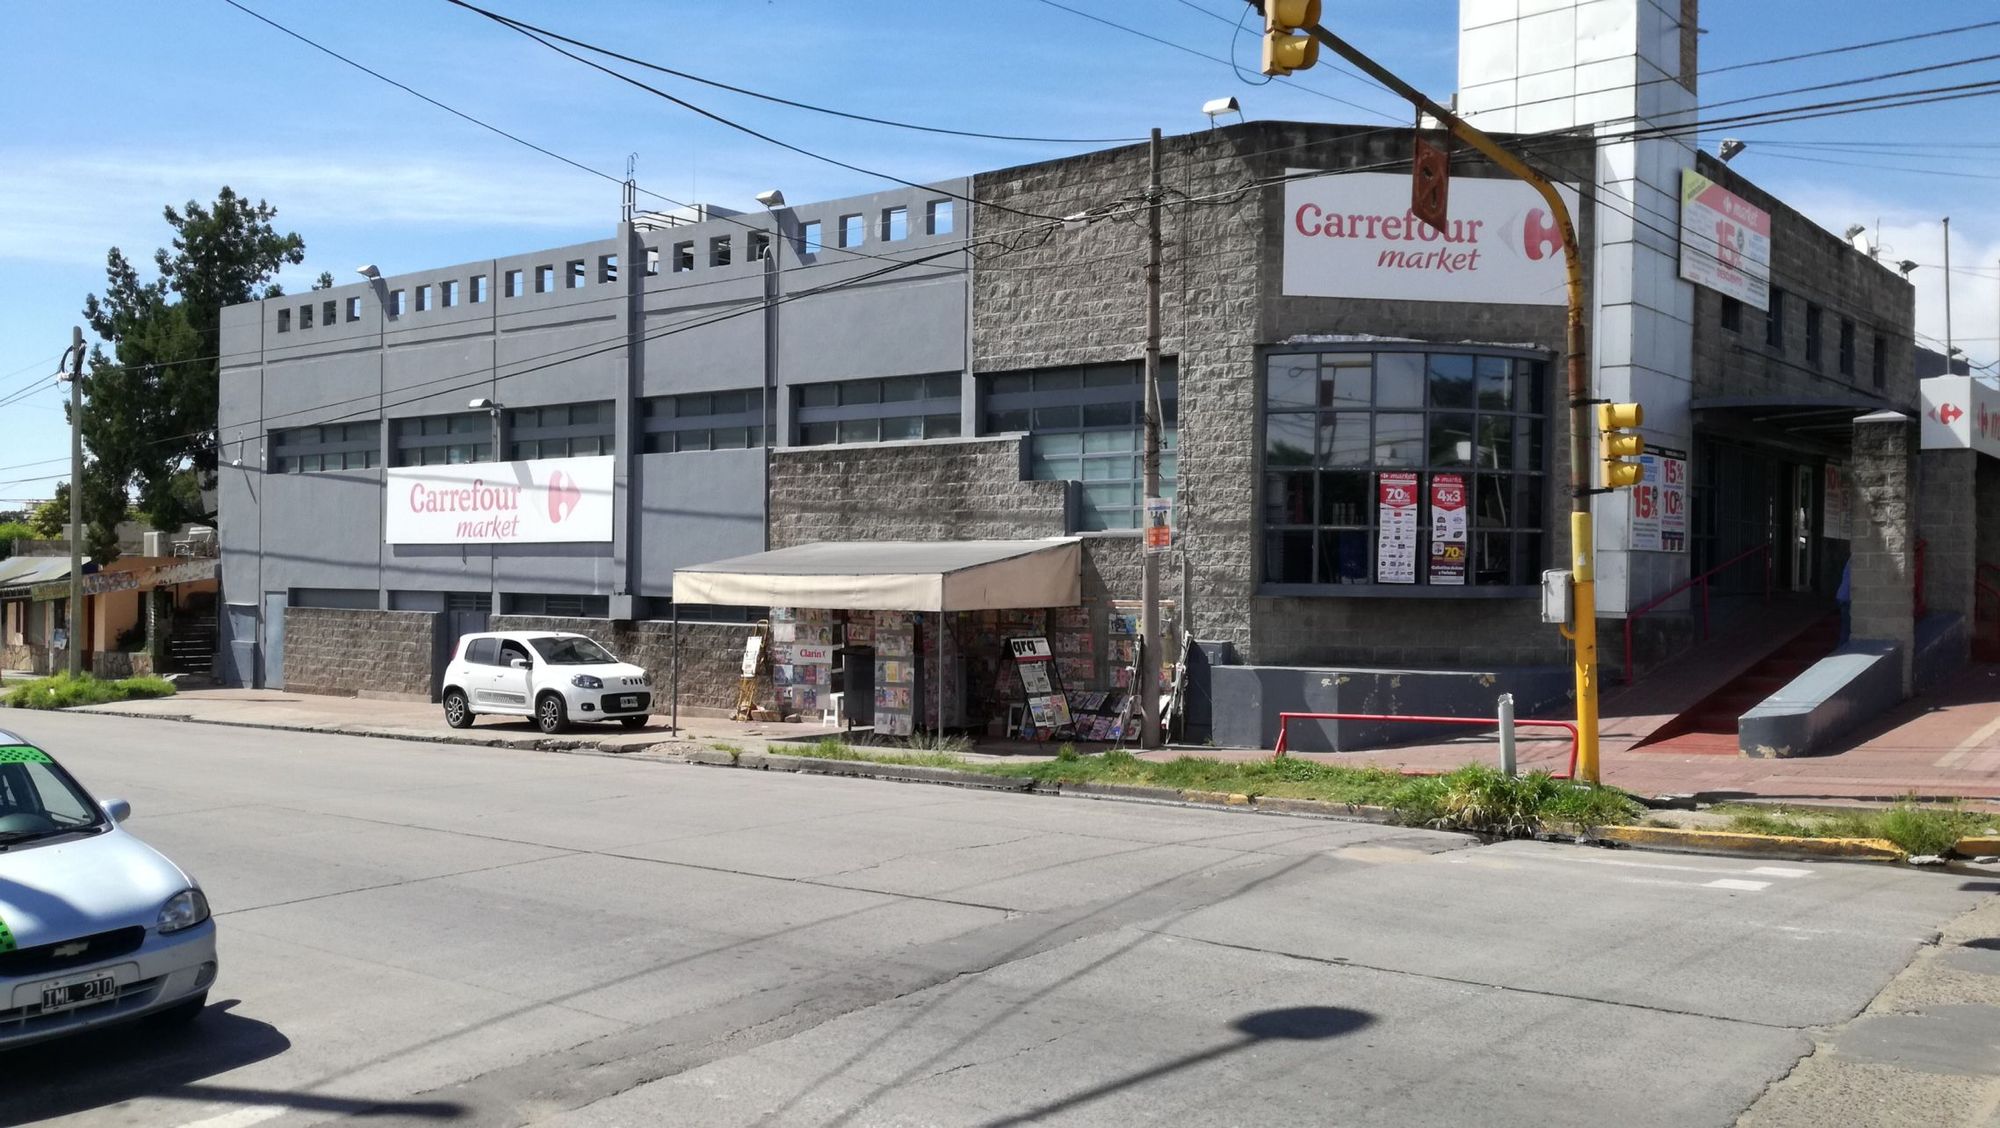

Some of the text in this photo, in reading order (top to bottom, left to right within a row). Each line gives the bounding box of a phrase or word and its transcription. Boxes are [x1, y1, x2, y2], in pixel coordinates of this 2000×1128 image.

[1295, 203, 1483, 244] Carrefour
[1377, 247, 1481, 273] market
[410, 479, 521, 513] Carrefour
[1437, 490, 1461, 502] 4x3
[456, 515, 520, 538] market
[45, 978, 113, 1008] IML 210
